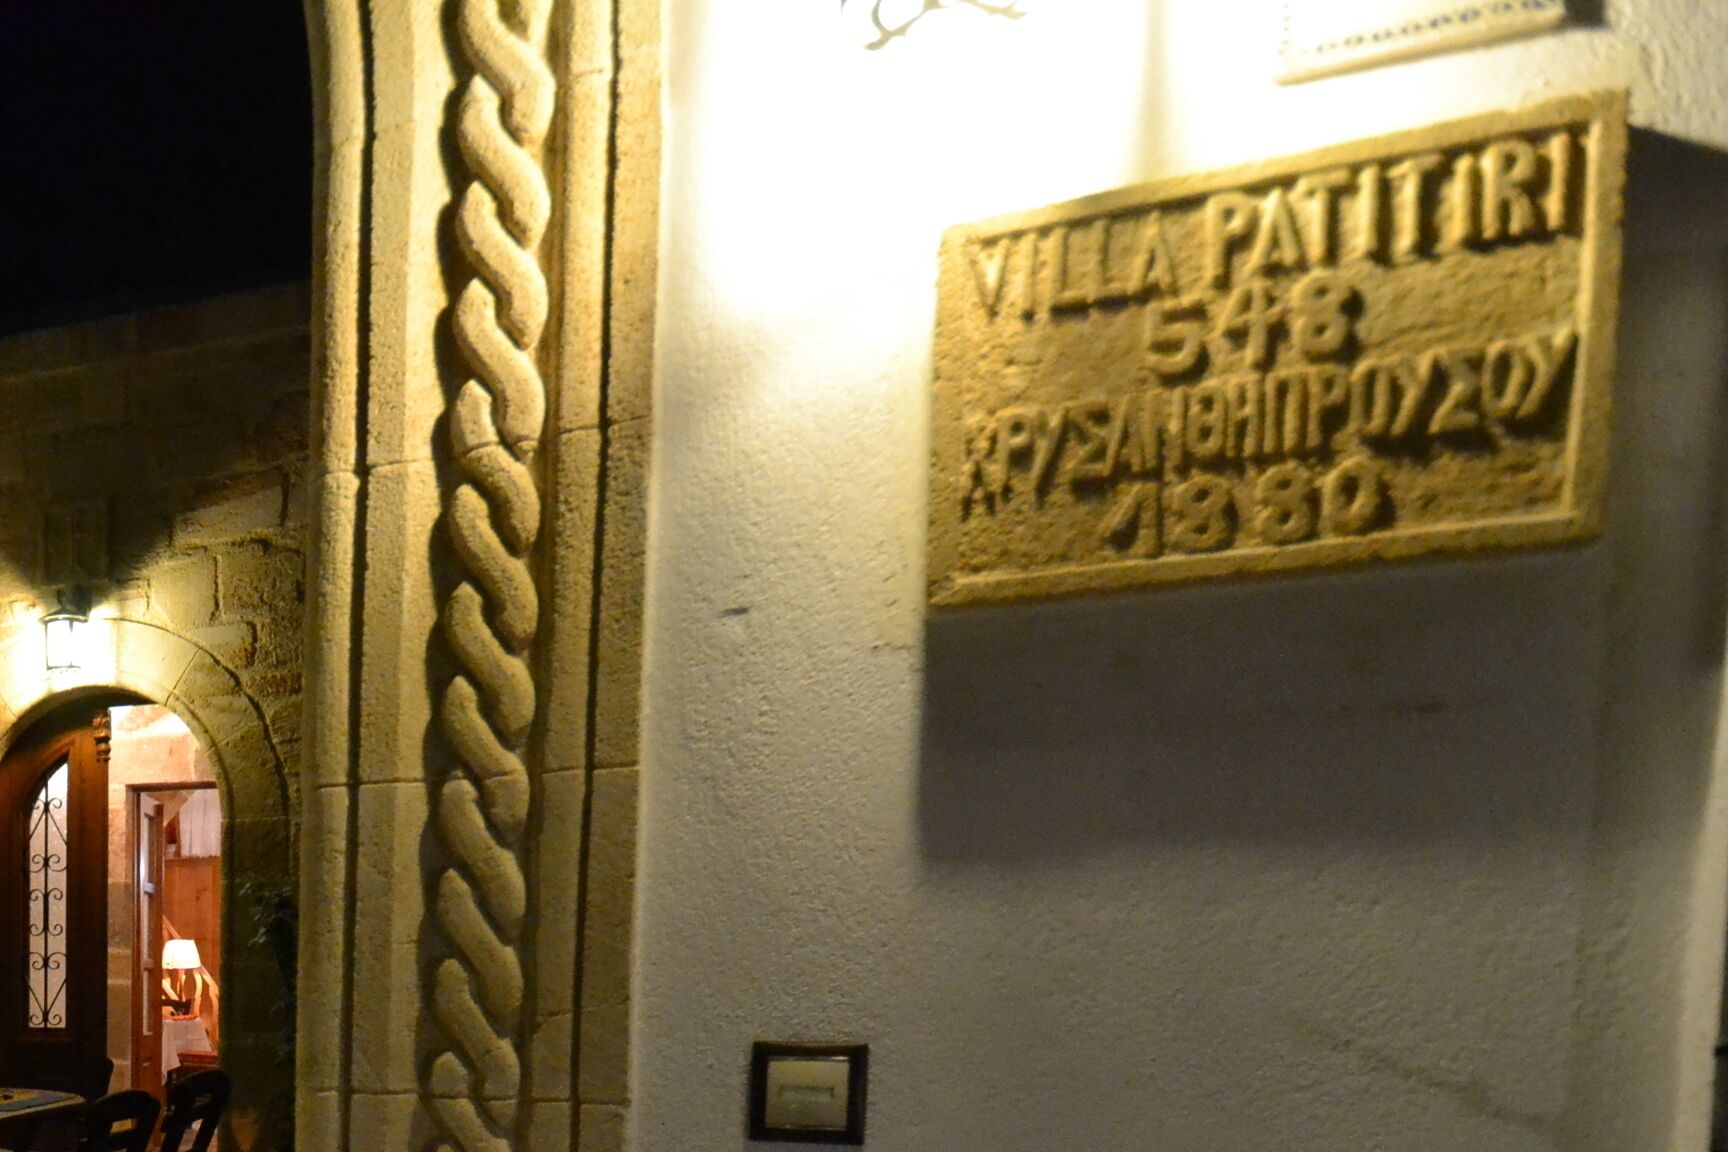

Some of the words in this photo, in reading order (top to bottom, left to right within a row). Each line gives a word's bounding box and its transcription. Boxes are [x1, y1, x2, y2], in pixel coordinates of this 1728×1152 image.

[970, 212, 1180, 316] VILLA
[1204, 132, 1574, 286] PATITIRI
[1144, 270, 1356, 372] 548
[1098, 456, 1384, 558] 1880
